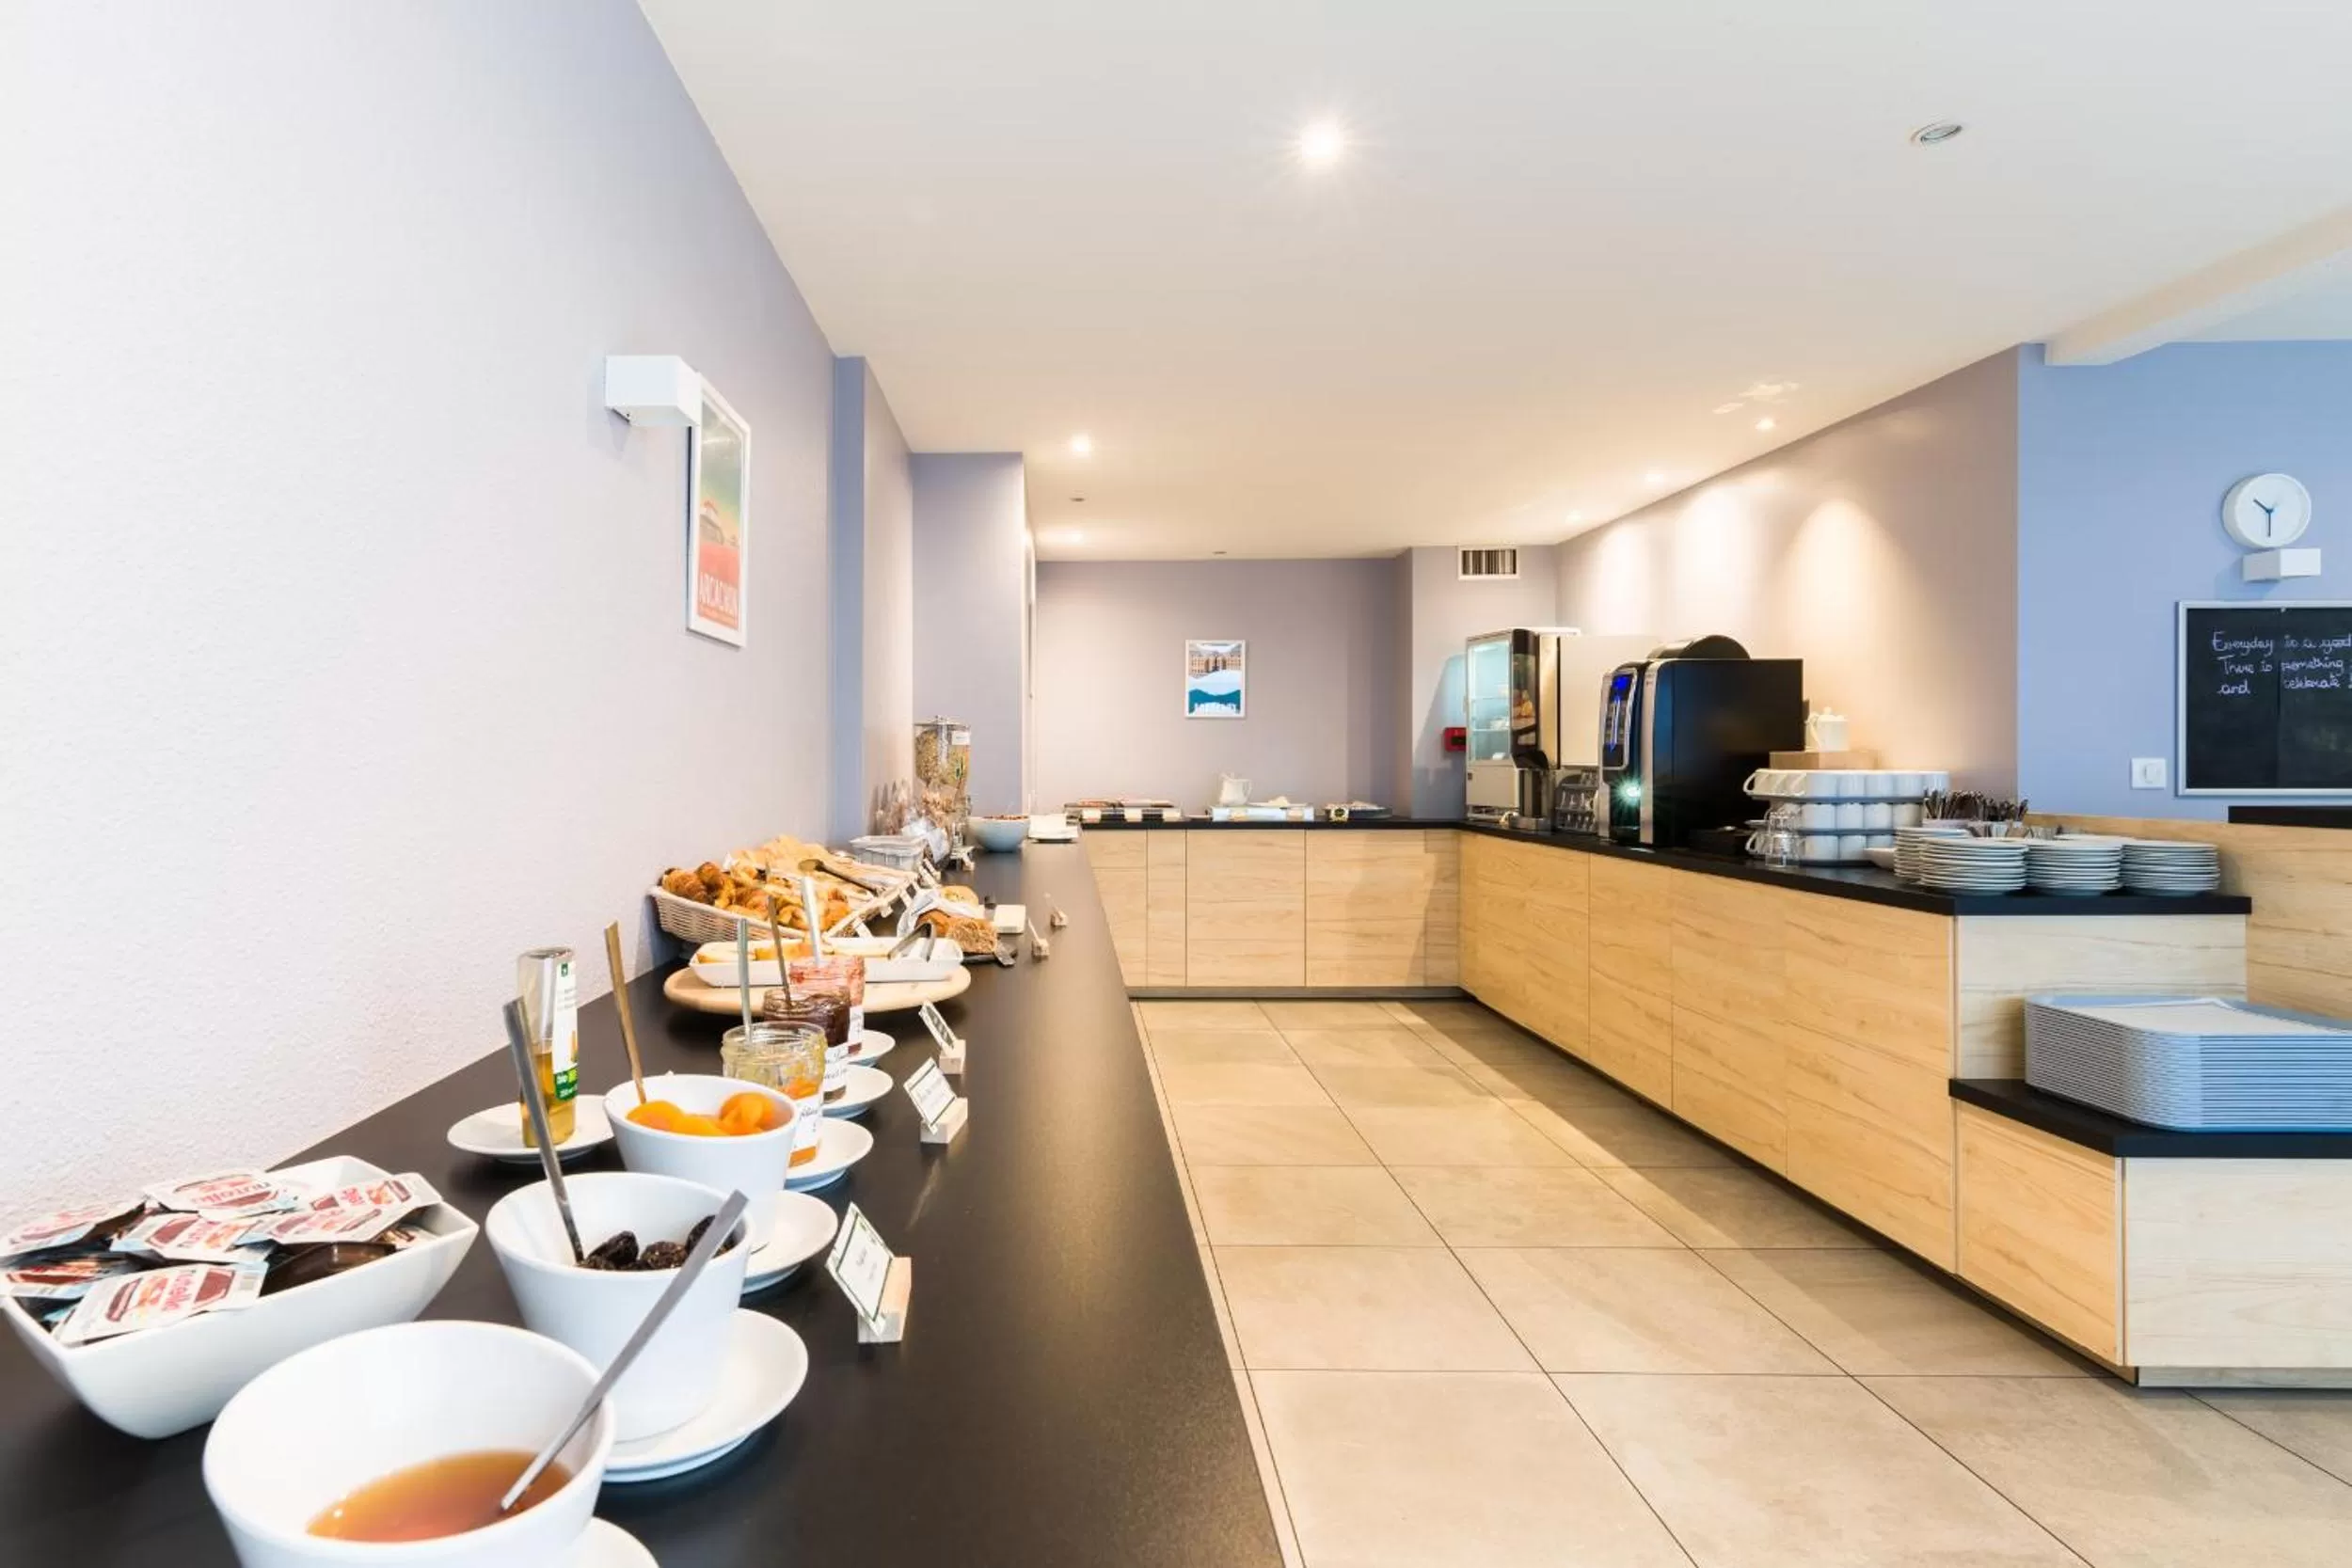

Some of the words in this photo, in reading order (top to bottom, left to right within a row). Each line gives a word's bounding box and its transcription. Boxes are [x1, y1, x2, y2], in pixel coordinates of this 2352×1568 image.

[2213, 631, 2273, 657] Everyday
[2302, 639, 2316, 648] a
[2260, 660, 2273, 672] is
[2217, 678, 2250, 694] and
